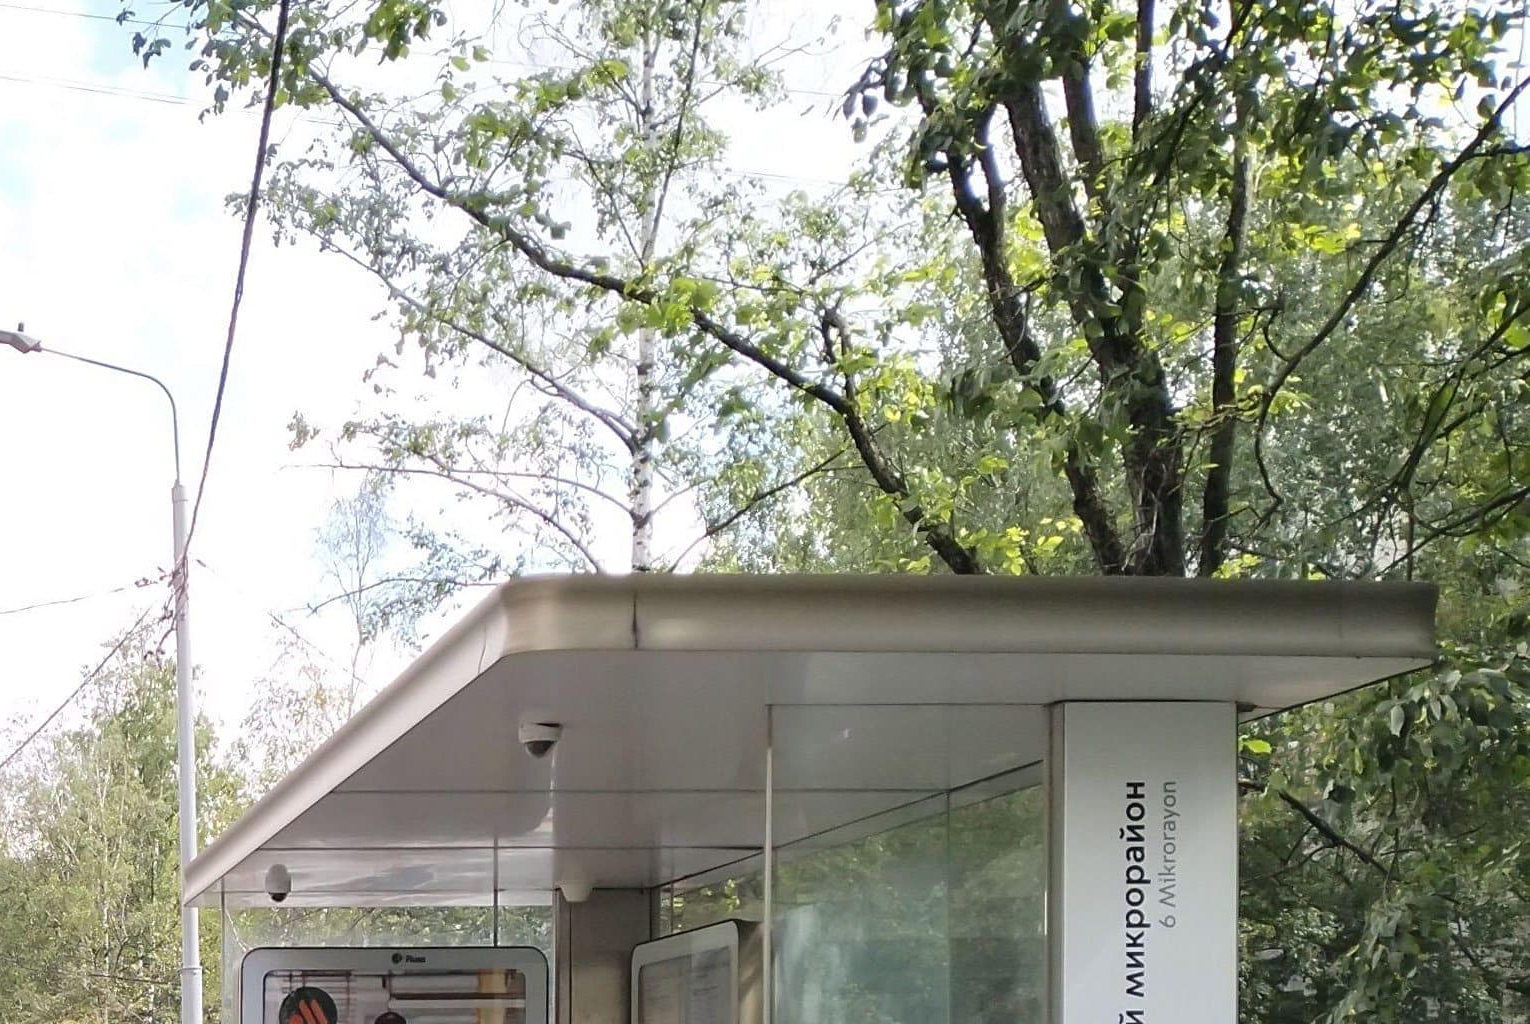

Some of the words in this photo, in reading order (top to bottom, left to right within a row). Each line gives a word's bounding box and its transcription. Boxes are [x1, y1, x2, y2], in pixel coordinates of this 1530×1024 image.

[1118, 781, 1152, 998] микрорайон
[1157, 780, 1181, 908] Mikrorayon
[1158, 915, 1176, 929] 6
